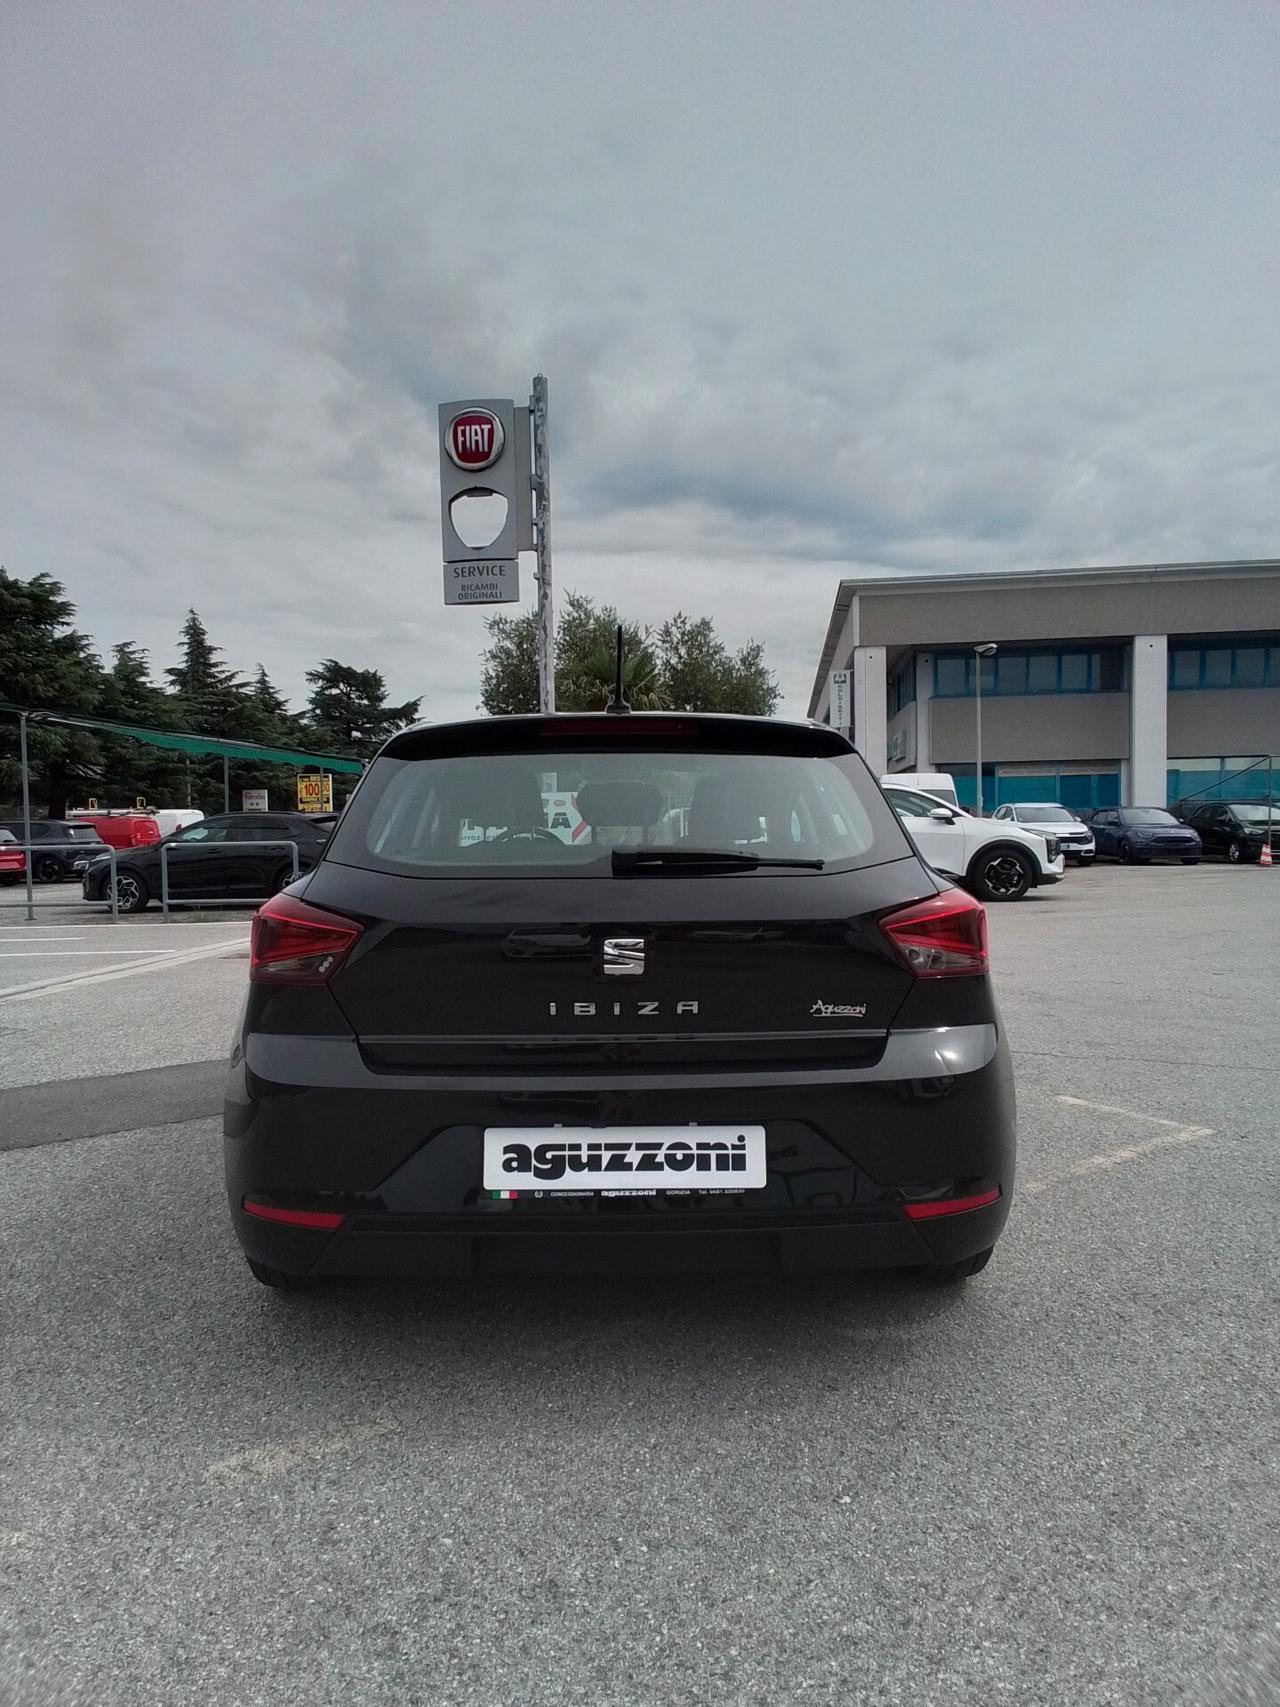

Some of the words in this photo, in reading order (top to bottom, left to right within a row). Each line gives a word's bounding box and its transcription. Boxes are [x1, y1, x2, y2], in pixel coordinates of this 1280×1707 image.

[457, 424, 492, 453] FIAT
[453, 564, 507, 578] SERVICE
[461, 583, 498, 592] RICAMBI
[457, 591, 503, 601] ORIGINALI
[549, 1000, 699, 1016] IBIZA
[501, 1134, 747, 1181] aguzzoni
